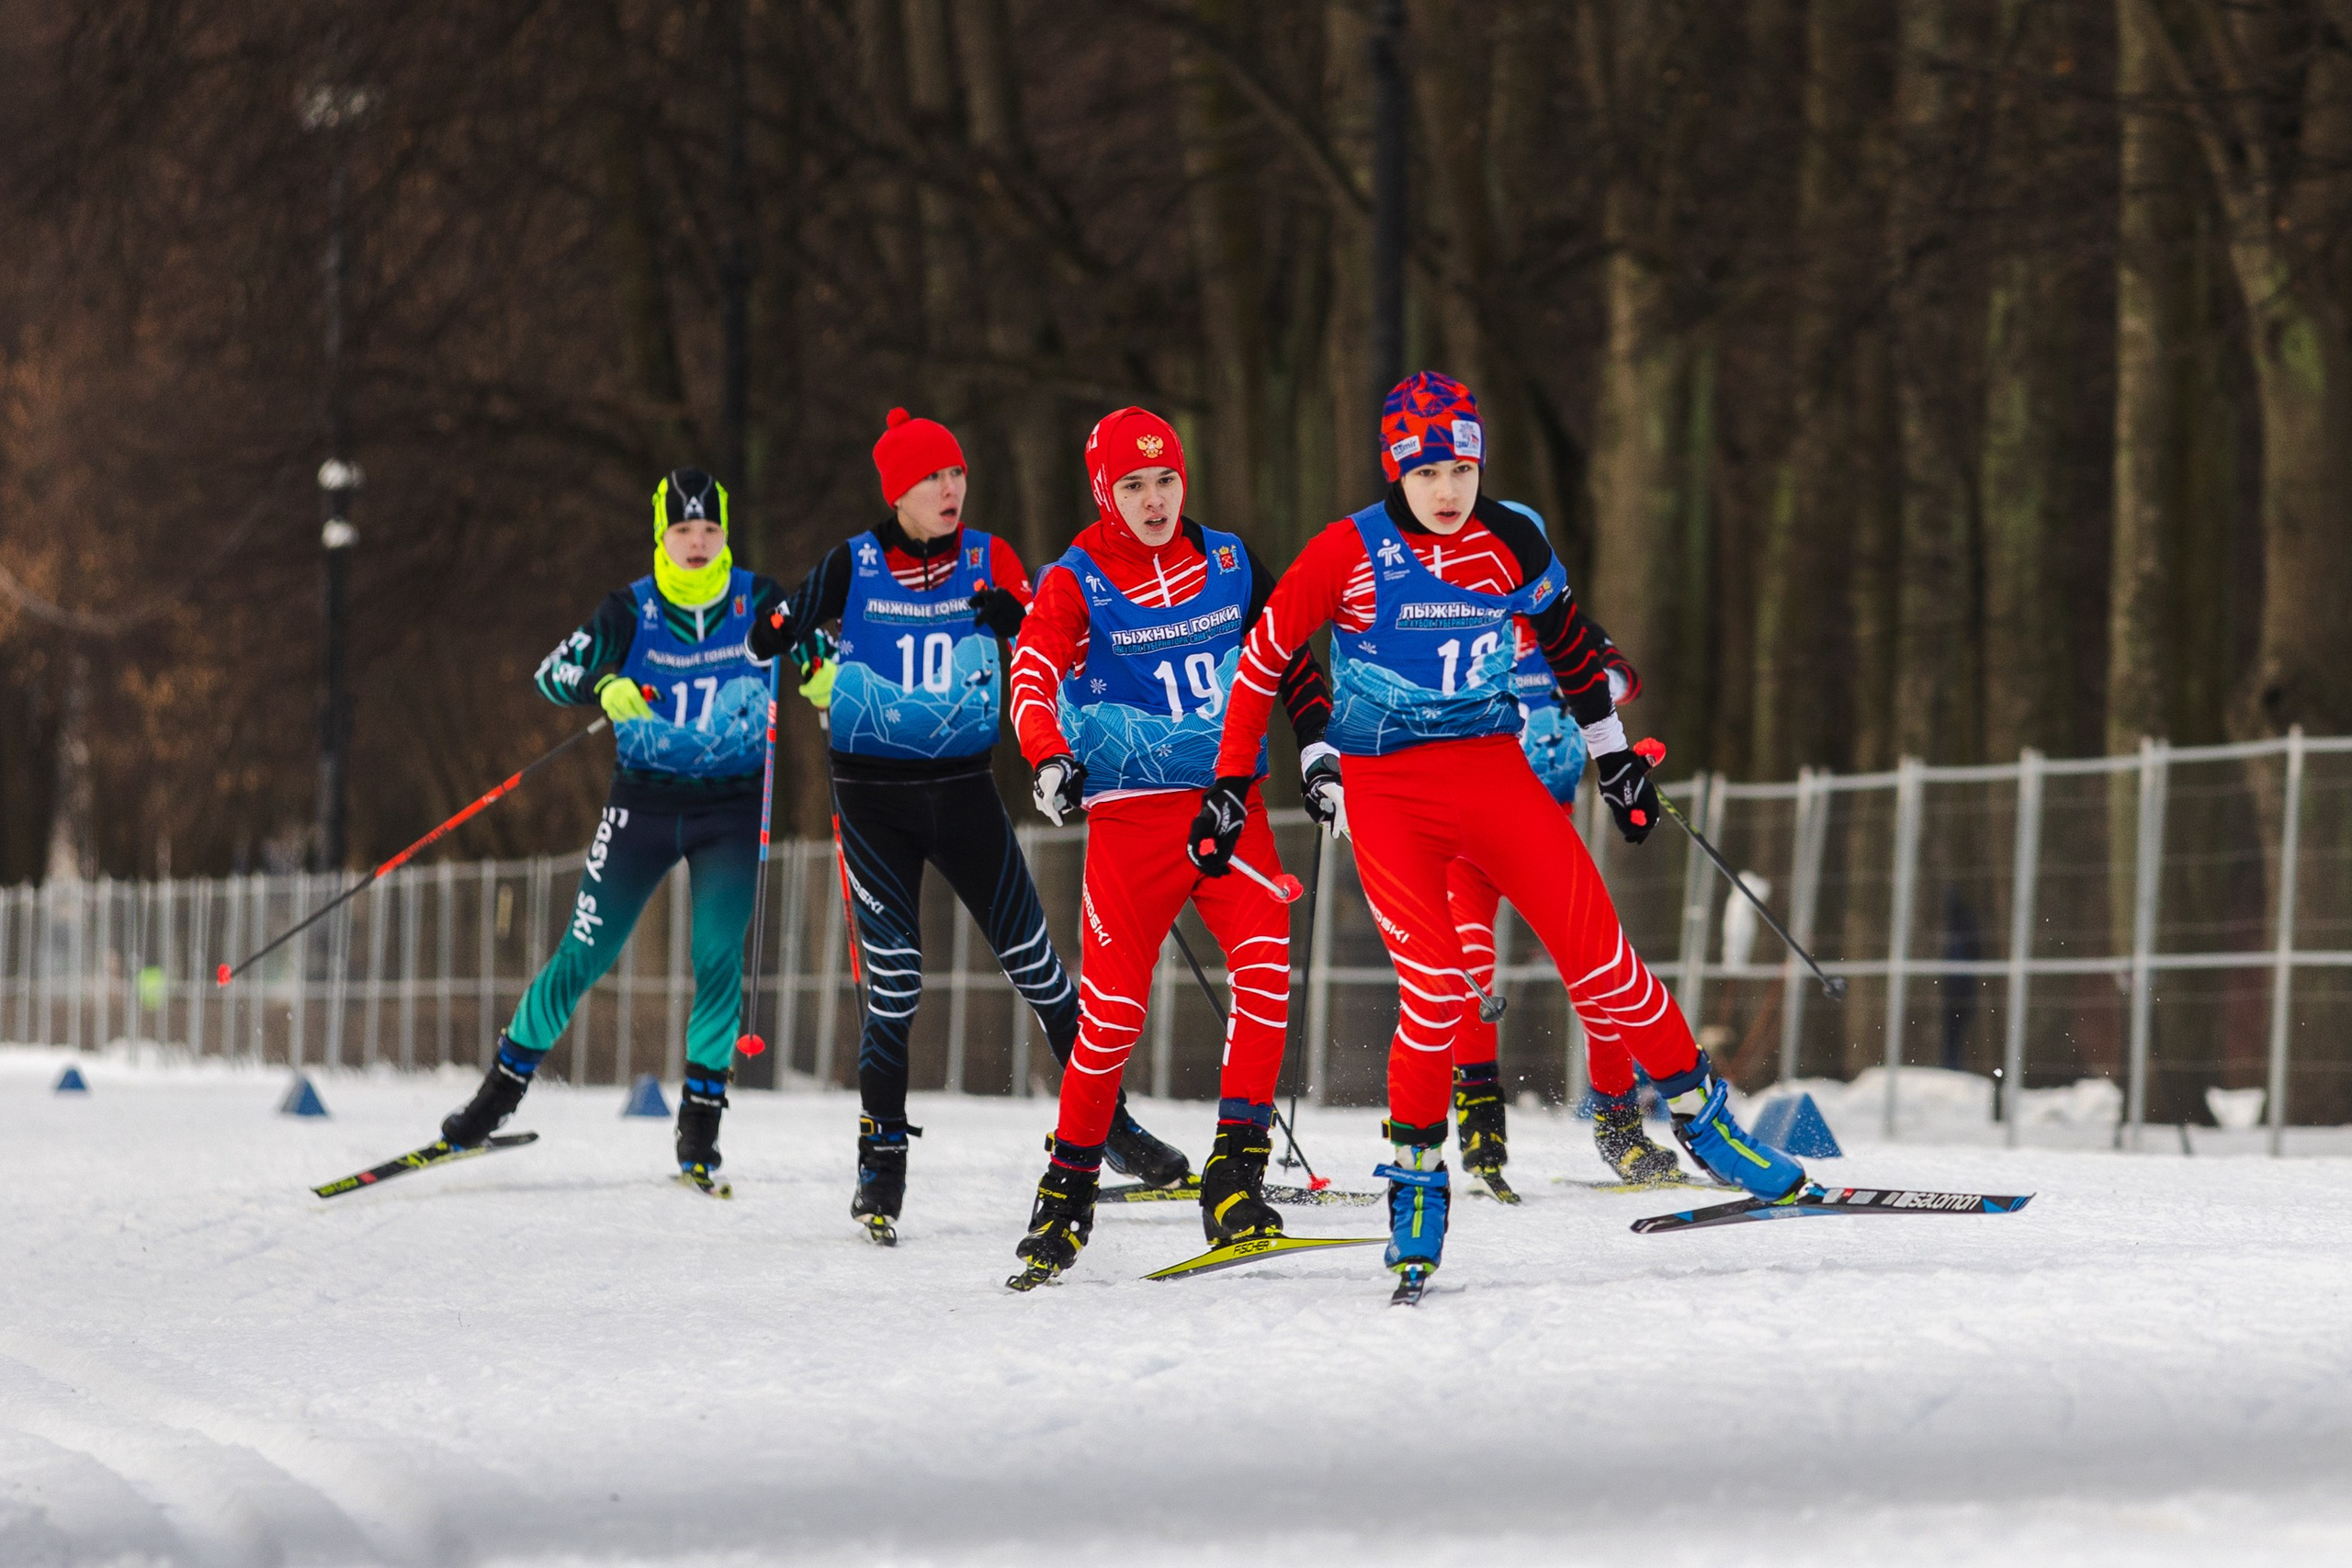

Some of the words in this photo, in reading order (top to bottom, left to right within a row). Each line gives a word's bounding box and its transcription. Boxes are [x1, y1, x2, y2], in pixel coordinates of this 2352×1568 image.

[867, 600, 933, 618] ЛЫЖНЫЕ
[934, 597, 971, 615] ГОНК
[1112, 624, 1188, 645] ЛЫЖНЫЕ
[1192, 606, 1239, 633] ГОНКИ
[896, 633, 953, 694] 10
[1153, 653, 1223, 723] 19
[671, 676, 718, 732] 17
[1082, 879, 1112, 947] ORDSKI
[1233, 1239, 1270, 1256] FISCHER
